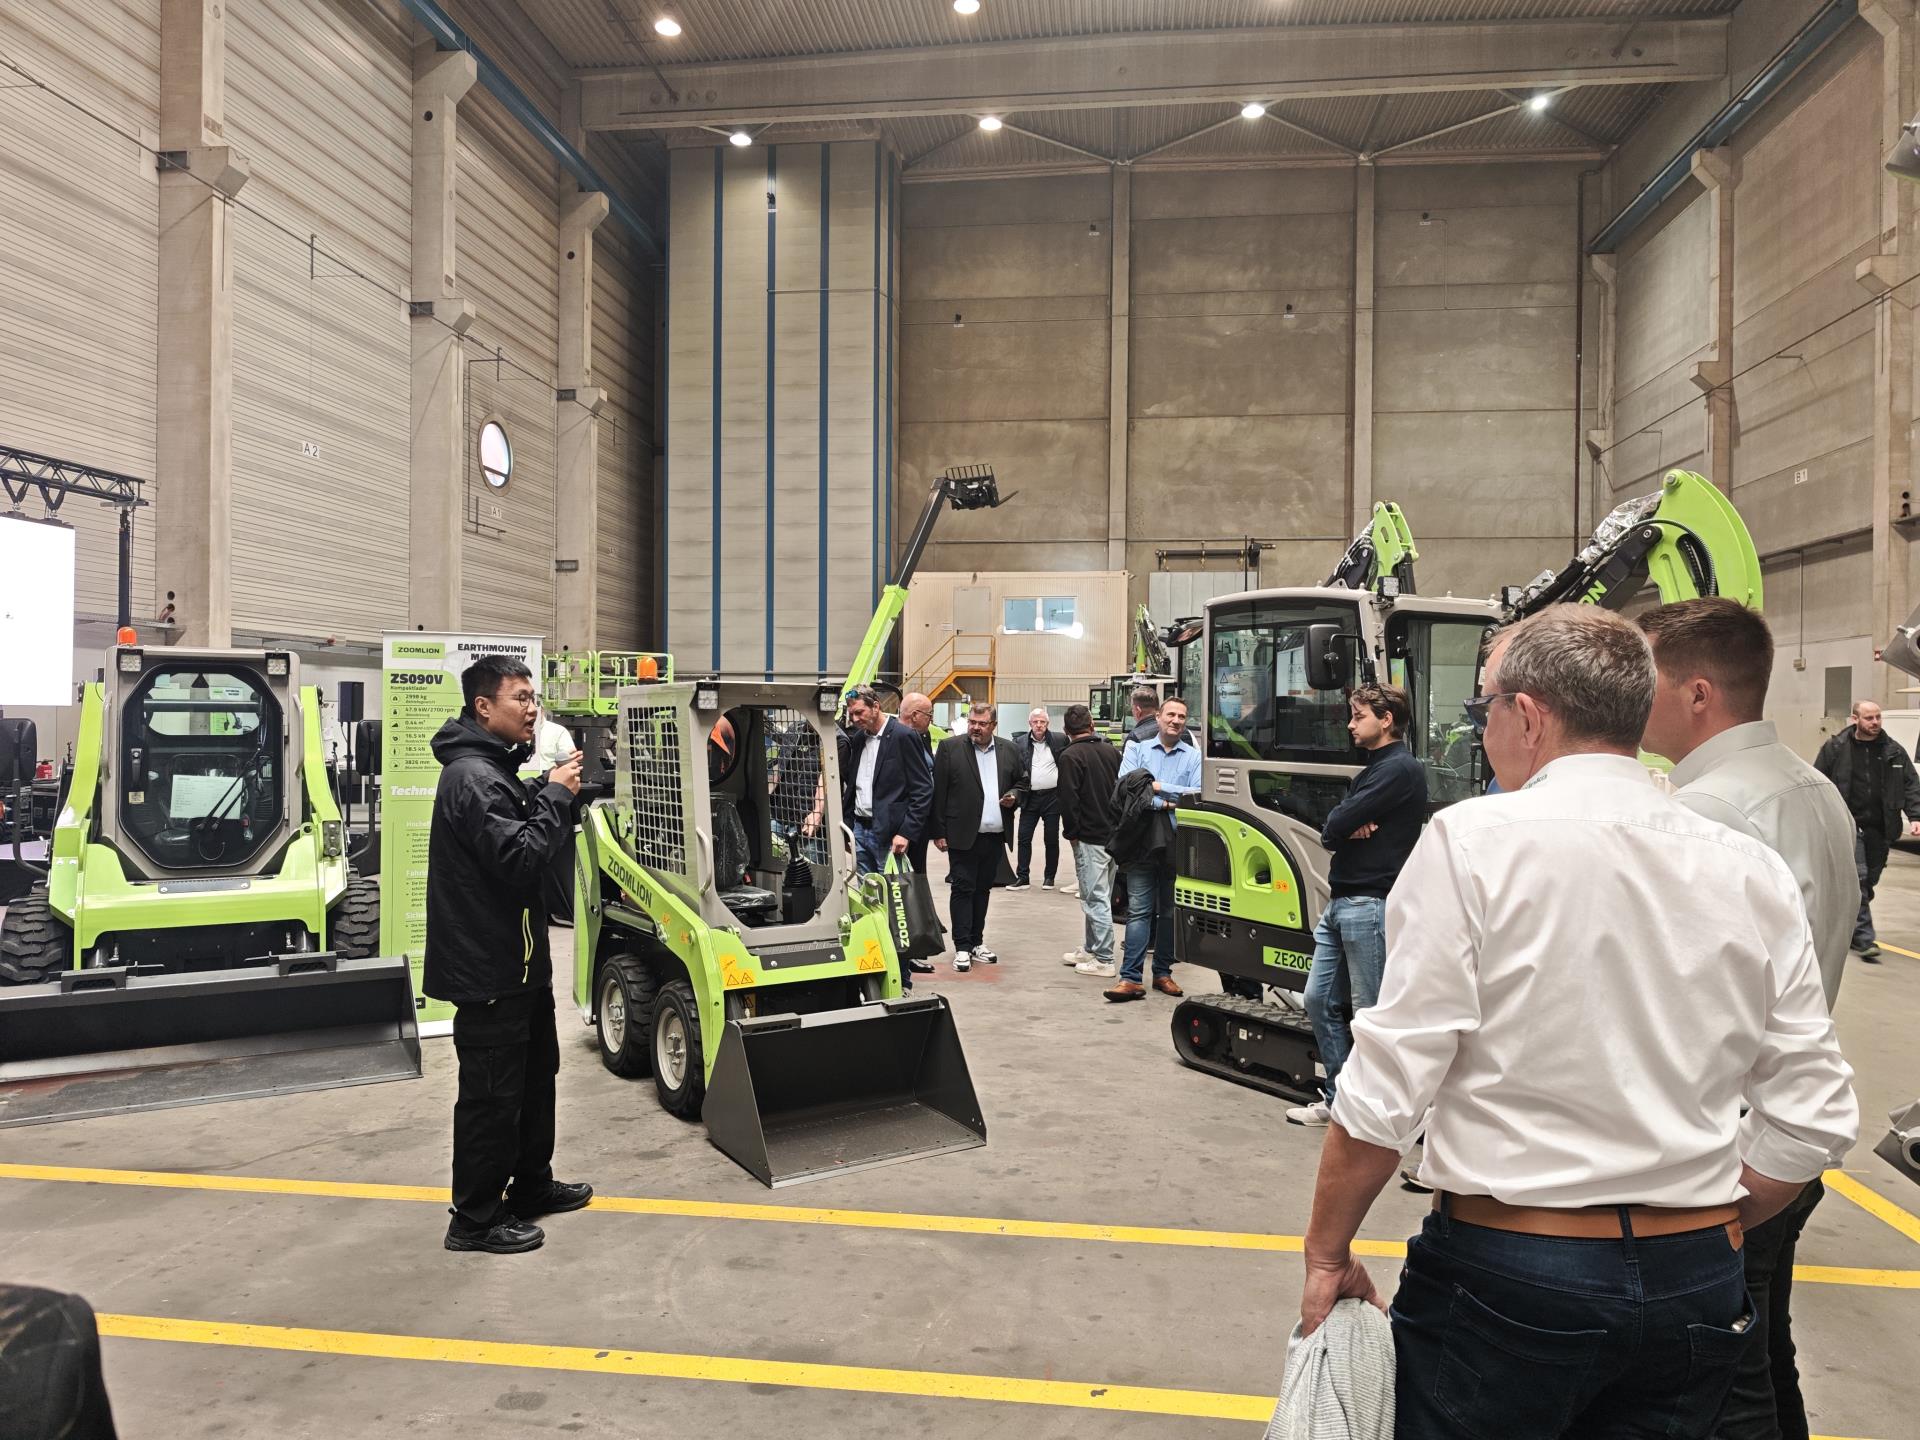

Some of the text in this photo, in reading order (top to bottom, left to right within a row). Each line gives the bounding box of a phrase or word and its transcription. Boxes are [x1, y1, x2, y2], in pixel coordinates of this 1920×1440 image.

[458, 644, 526, 652] EARTHMOVING
[390, 674, 443, 684] ZS090V
[608, 856, 652, 908] ZOOMLION
[891, 882, 910, 948] ZOOMLION
